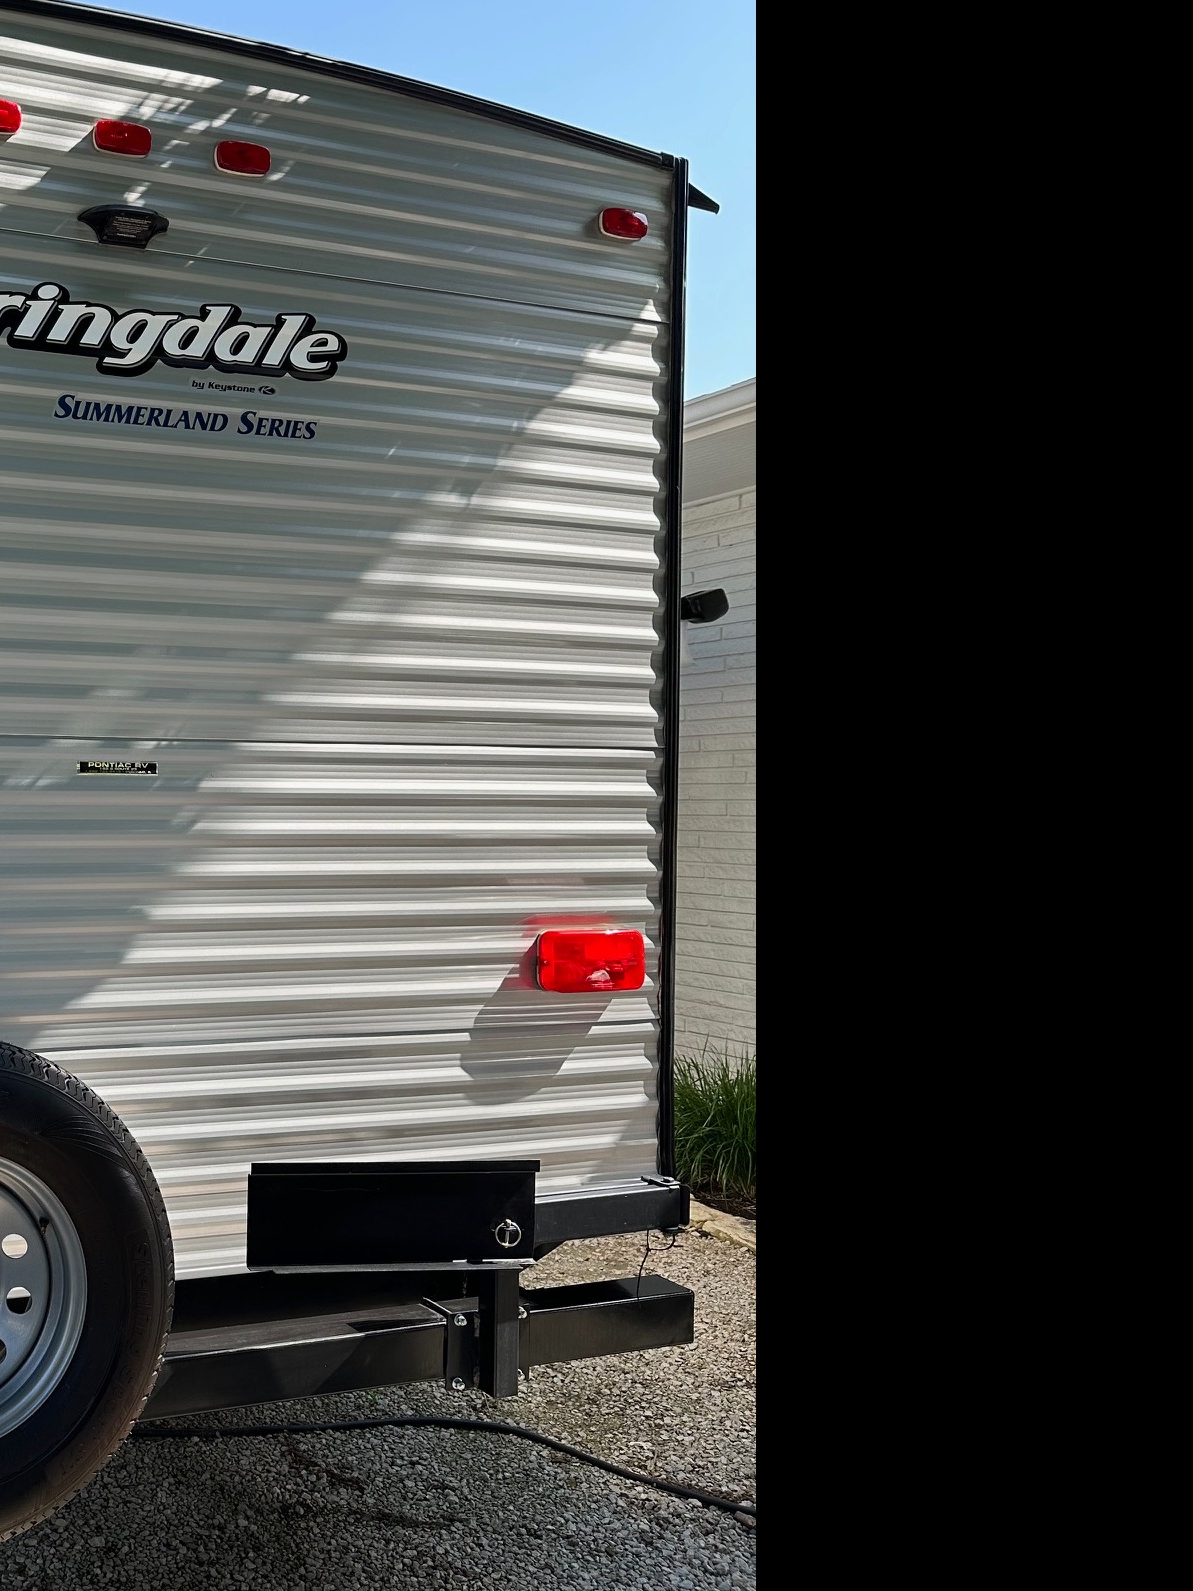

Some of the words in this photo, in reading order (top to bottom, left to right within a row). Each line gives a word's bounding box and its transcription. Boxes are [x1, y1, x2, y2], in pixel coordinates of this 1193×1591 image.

[192, 380, 205, 389] by
[208, 382, 256, 393] Keystone
[54, 394, 229, 434] SUMMERLAND
[236, 410, 318, 441] SERIES
